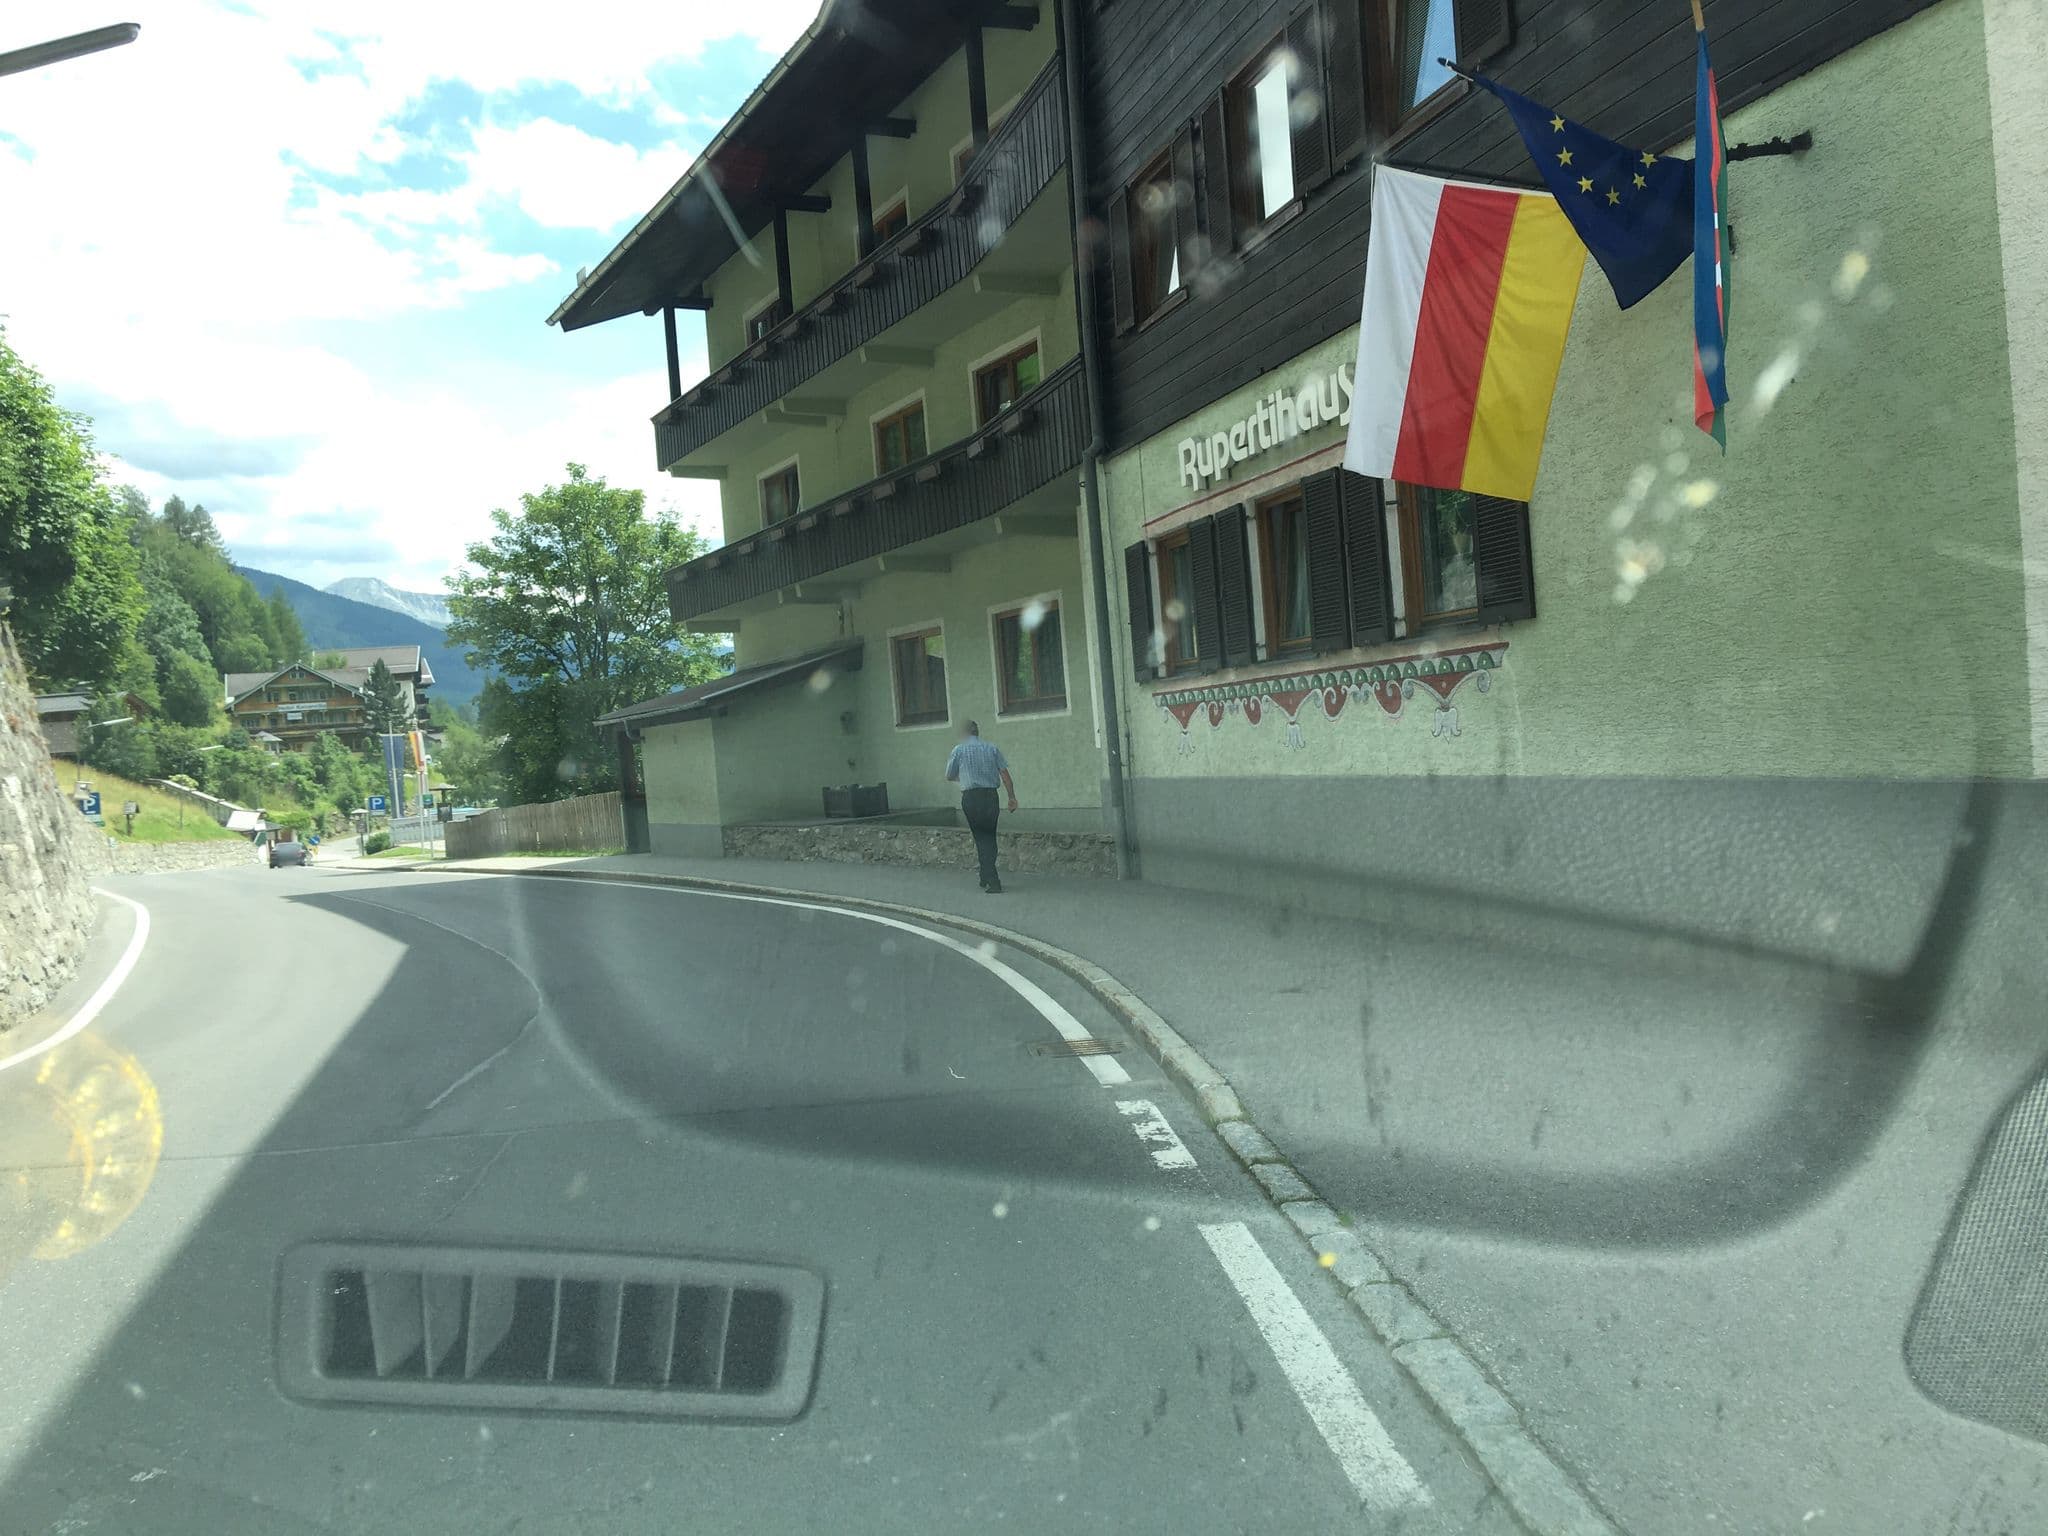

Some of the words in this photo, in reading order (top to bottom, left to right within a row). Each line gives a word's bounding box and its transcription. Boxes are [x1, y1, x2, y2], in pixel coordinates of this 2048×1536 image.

[1178, 363, 1355, 491] Rupertihaus
[83, 797, 96, 811] P
[372, 797, 383, 810] P
